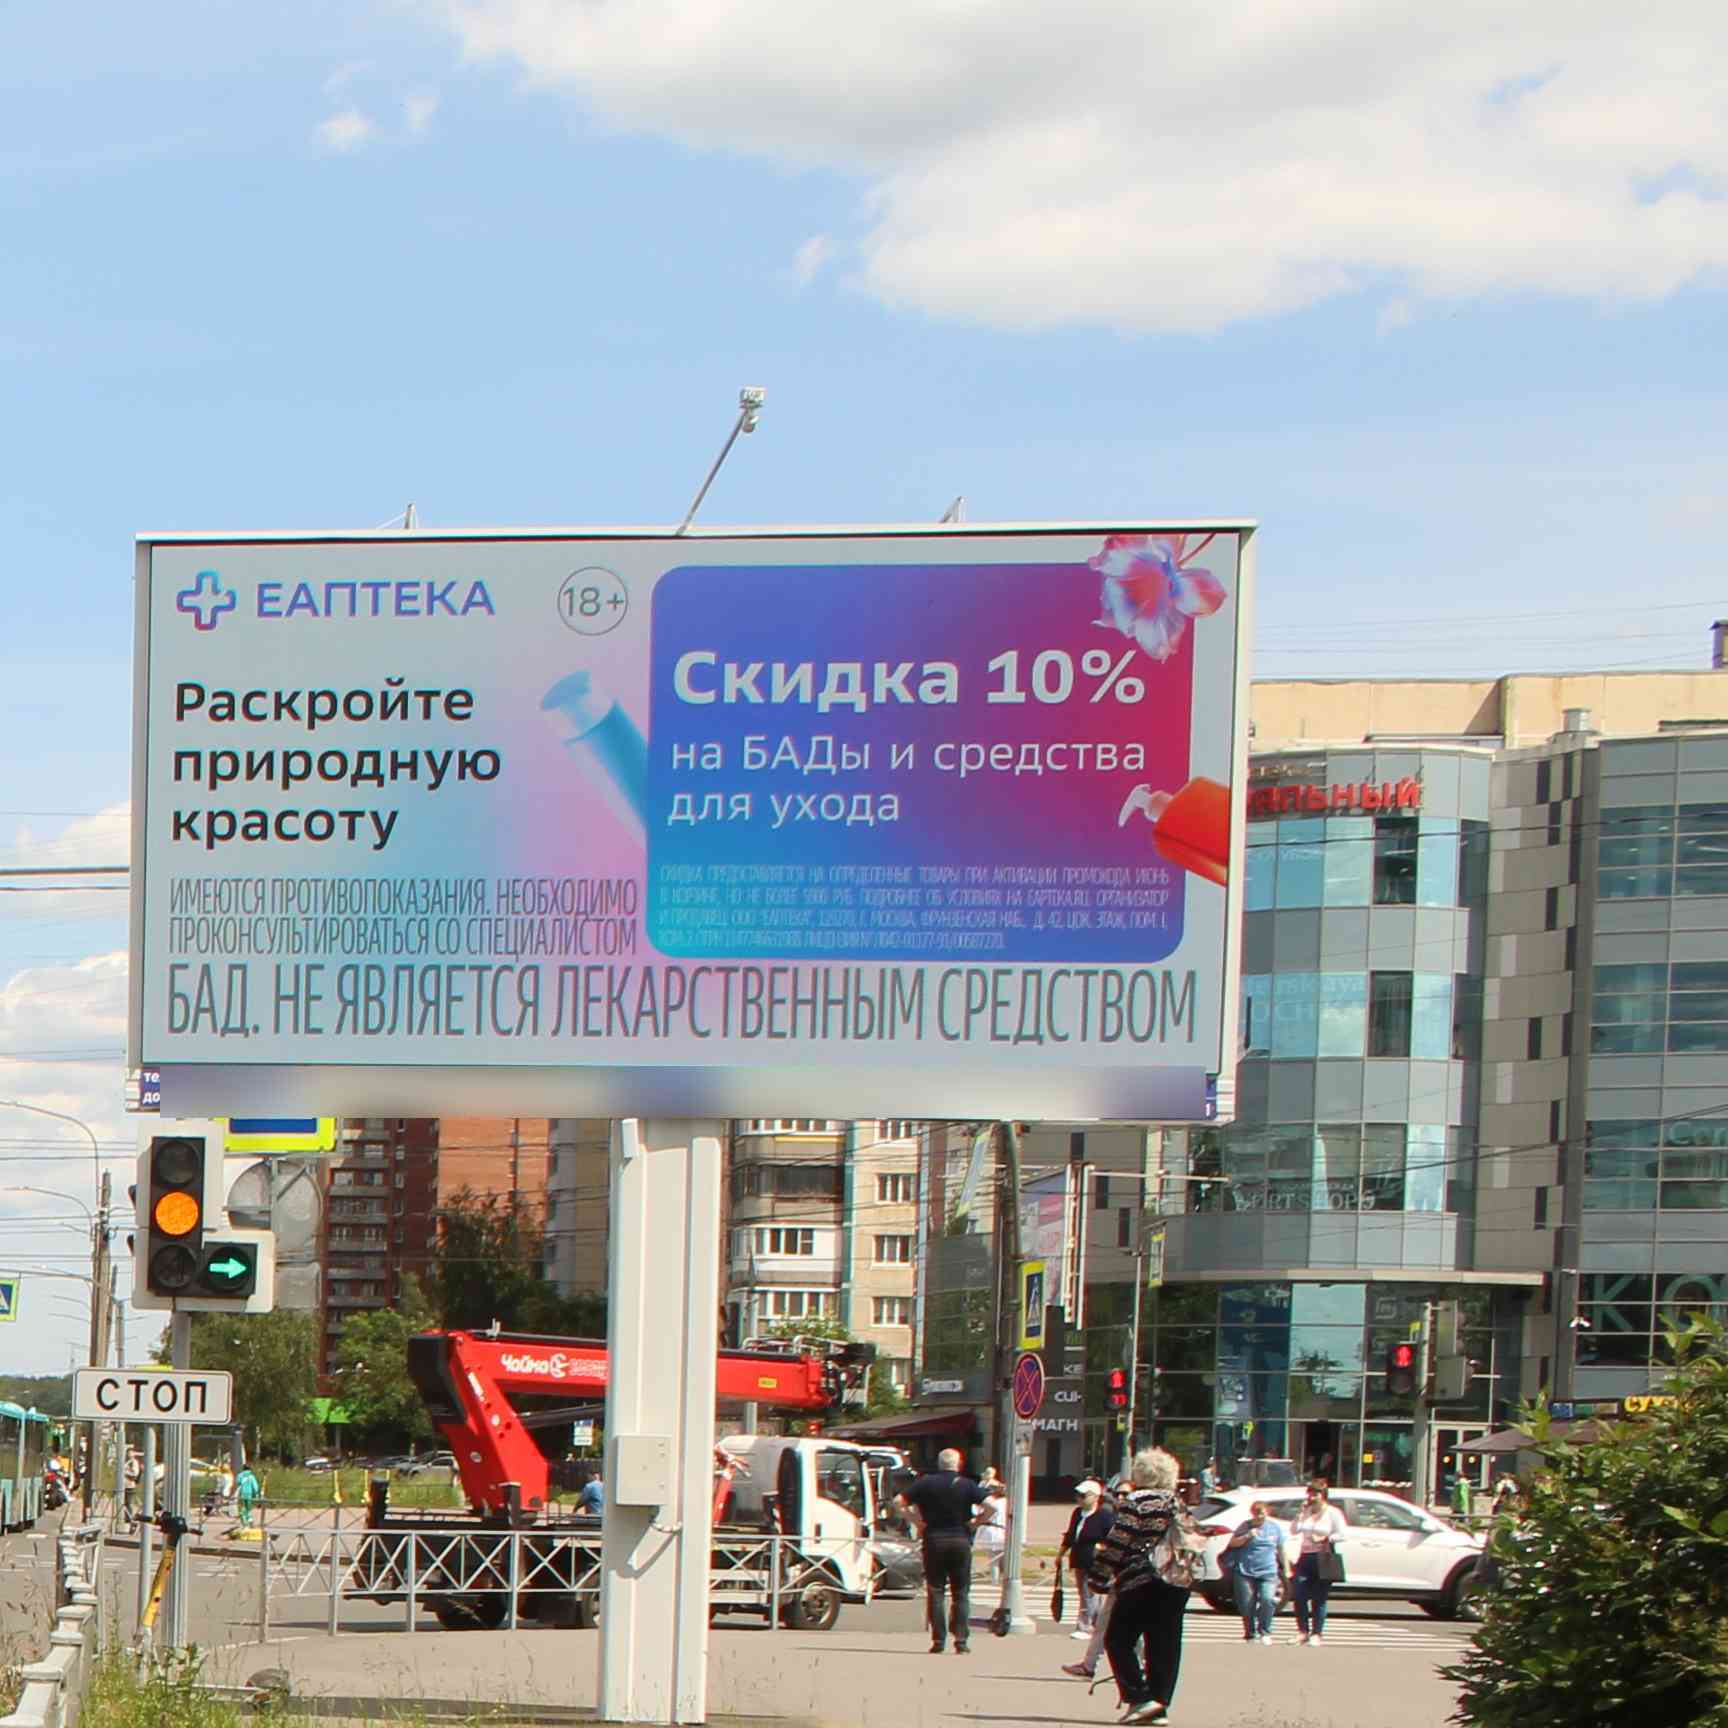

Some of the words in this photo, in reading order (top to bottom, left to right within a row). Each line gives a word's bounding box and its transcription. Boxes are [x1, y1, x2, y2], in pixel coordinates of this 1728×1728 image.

[256, 580, 496, 618] ЕАПТЕКА
[561, 586, 625, 618] 18+
[673, 650, 960, 713] Скидка
[985, 648, 1146, 705] 10%
[174, 676, 475, 731] Раскройте
[173, 747, 501, 791] природную
[671, 741, 723, 771] на
[742, 735, 871, 776] БАДы
[890, 742, 915, 771] и
[933, 741, 1146, 778] средства
[667, 794, 752, 826] для
[770, 794, 900, 829] ухода
[1247, 776, 1421, 816] АЛЬНЫЙ
[171, 809, 399, 850] красоту
[168, 877, 266, 915] ИМЕЮТСЯ
[271, 878, 492, 916] ПРОТИВОПОКАЗАНИЯ.
[497, 879, 638, 919] НЕОБХОДИМО
[168, 917, 429, 956] ПРОКОНСУЛЬТИРОВАТЬСЯ
[433, 918, 462, 955] СО
[466, 918, 638, 963] СПЕЦИАЛИСТОМ
[167, 963, 261, 1038] БАД.
[273, 963, 326, 1035] НЕ
[334, 964, 540, 1036] ЯВЛЯЕТСЯ
[550, 965, 926, 1041] ЛЕКАРСТВЕННЫМ
[938, 968, 1197, 1046] СРЕДСТВОМ
[95, 1377, 207, 1413] СТОП
